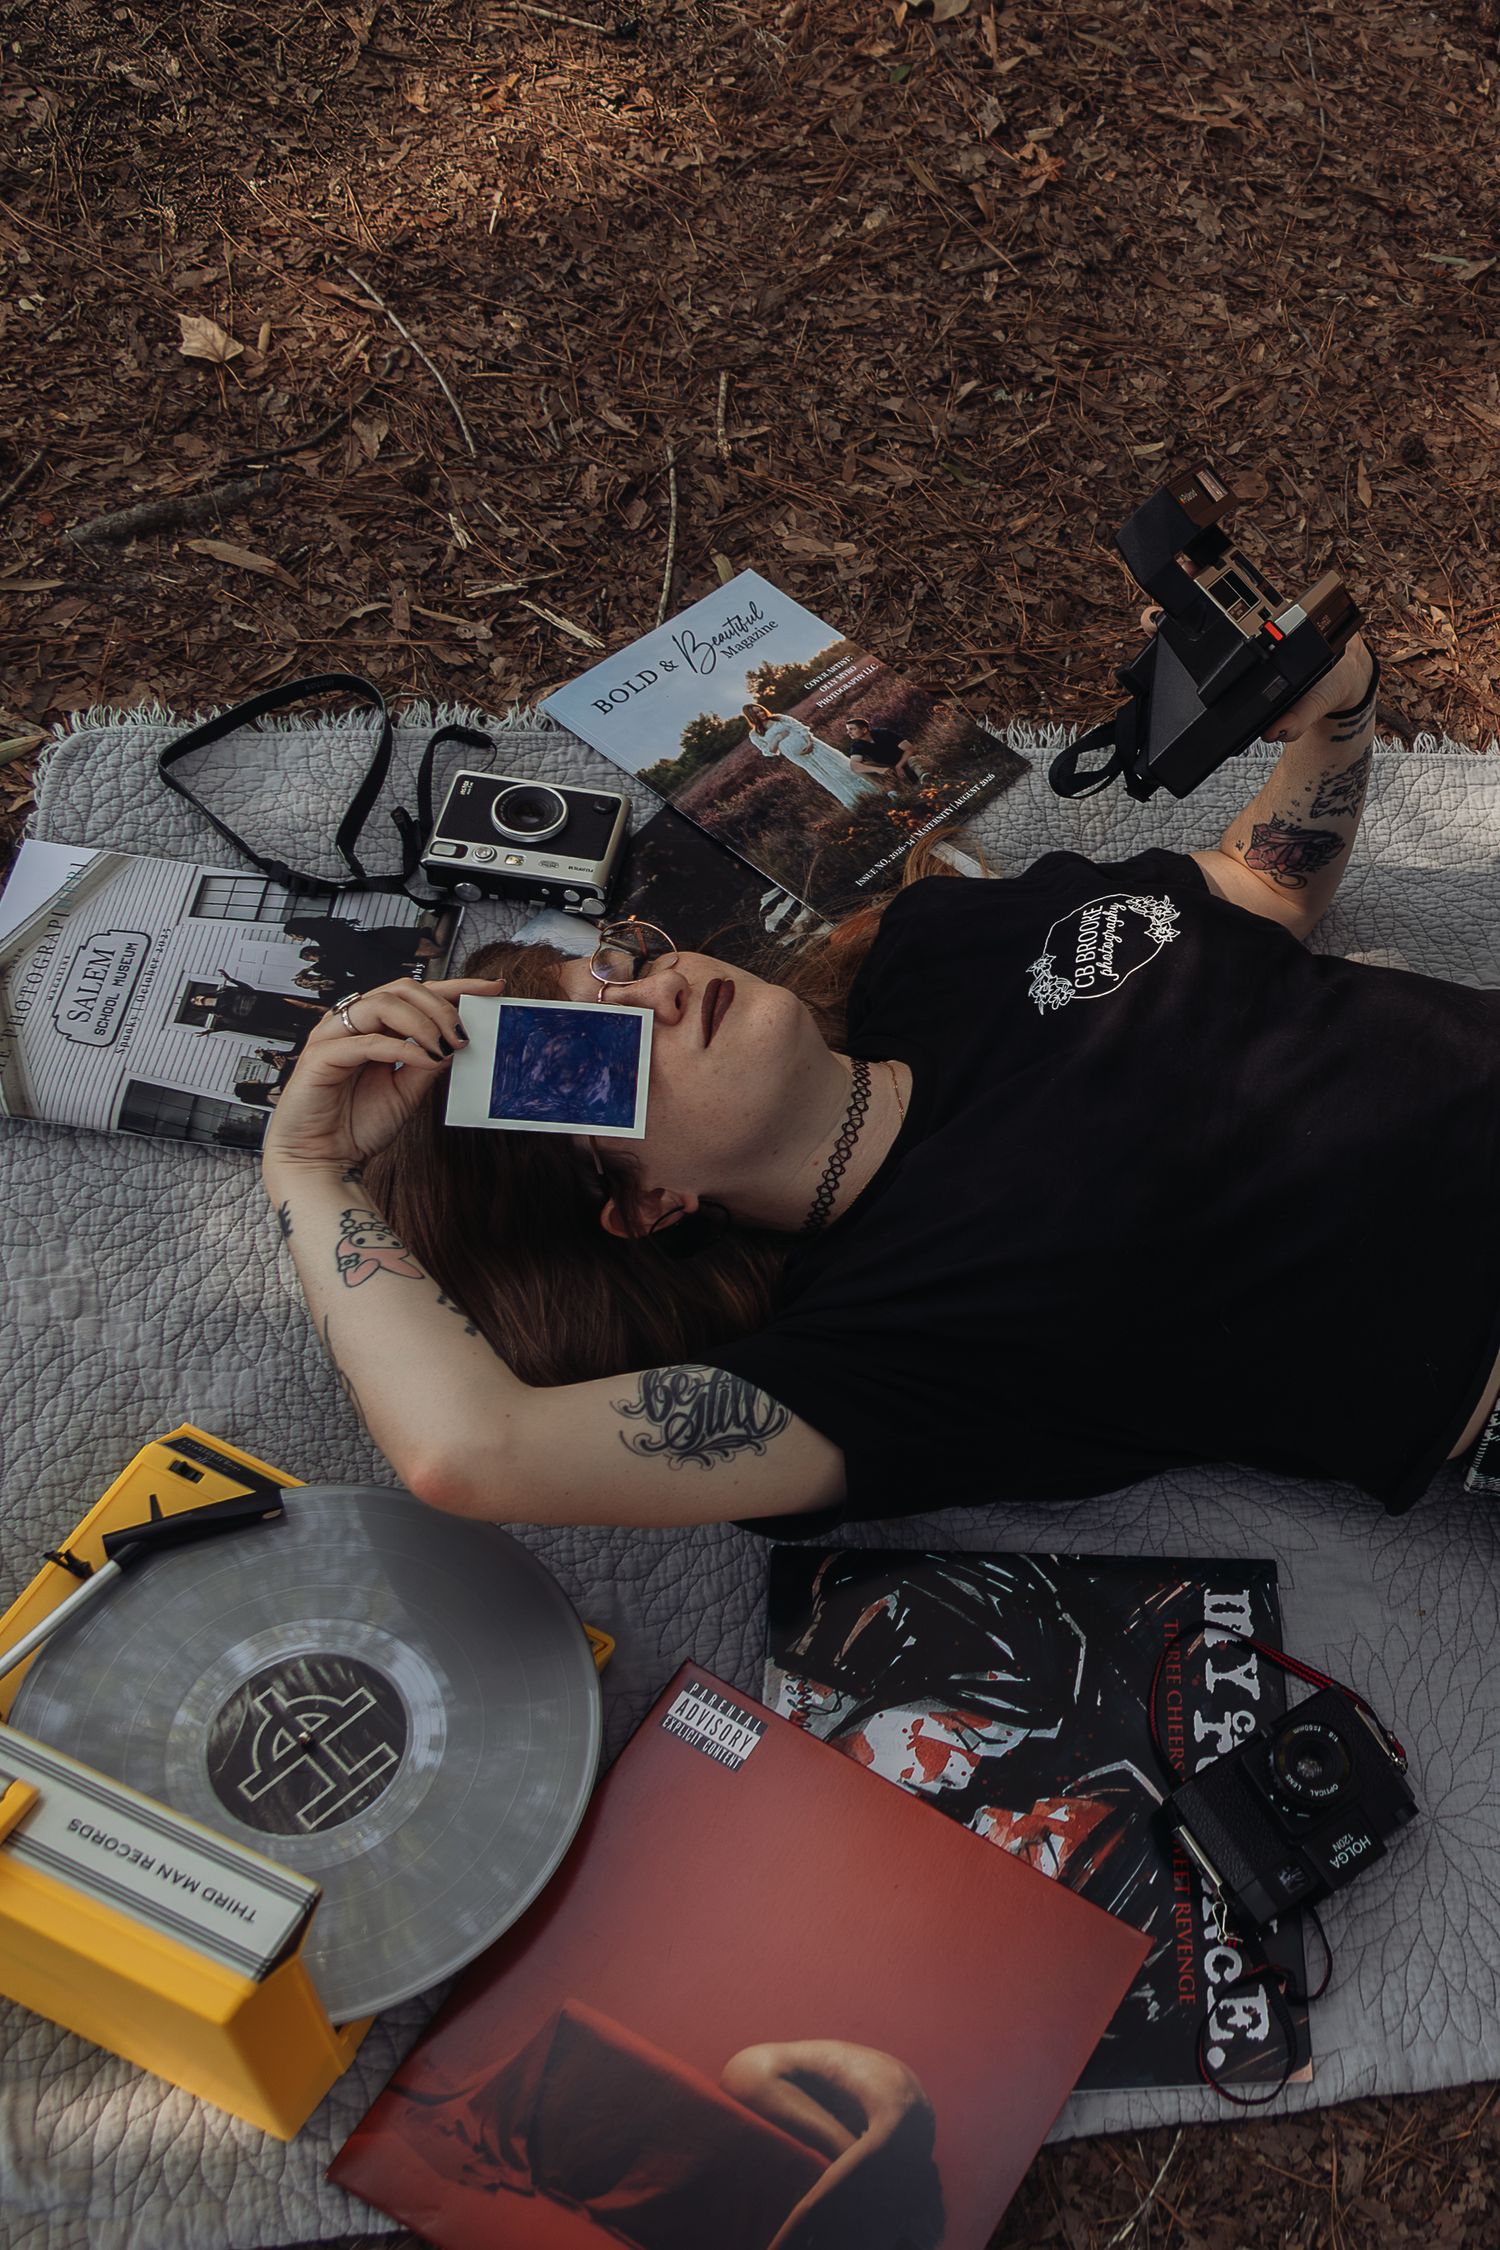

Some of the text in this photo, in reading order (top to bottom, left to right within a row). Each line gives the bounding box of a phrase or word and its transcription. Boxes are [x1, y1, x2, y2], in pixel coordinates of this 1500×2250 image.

[591, 600, 764, 715] BOLD & Beautiful
[720, 620, 779, 659] Magazine
[953, 784, 981, 808] AUGUST
[1074, 905, 1104, 989] CB BROOKE
[1095, 902, 1127, 982] photography
[67, 947, 116, 1022] SALEM
[94, 942, 139, 1036] SCHOOL MUSEUM
[115, 1015, 141, 1055] Spooky
[135, 957, 159, 1003] October
[674, 1697, 753, 1753] ADVISORY
[689, 1682, 762, 1734] PARENTAL
[1167, 1690, 1186, 1771] CHEERS
[662, 1716, 742, 1770] EXPLICIT CONTENT
[1285, 1773, 1340, 1797] OPTICAL LENS
[66, 1817, 257, 1924] THIRD MAN RECORDS
[1172, 1835, 1191, 1896] WEET
[1329, 1835, 1372, 1869] HOLGA
[1332, 1832, 1355, 1852] 120N
[1175, 1902, 1197, 2005] REVENGE
